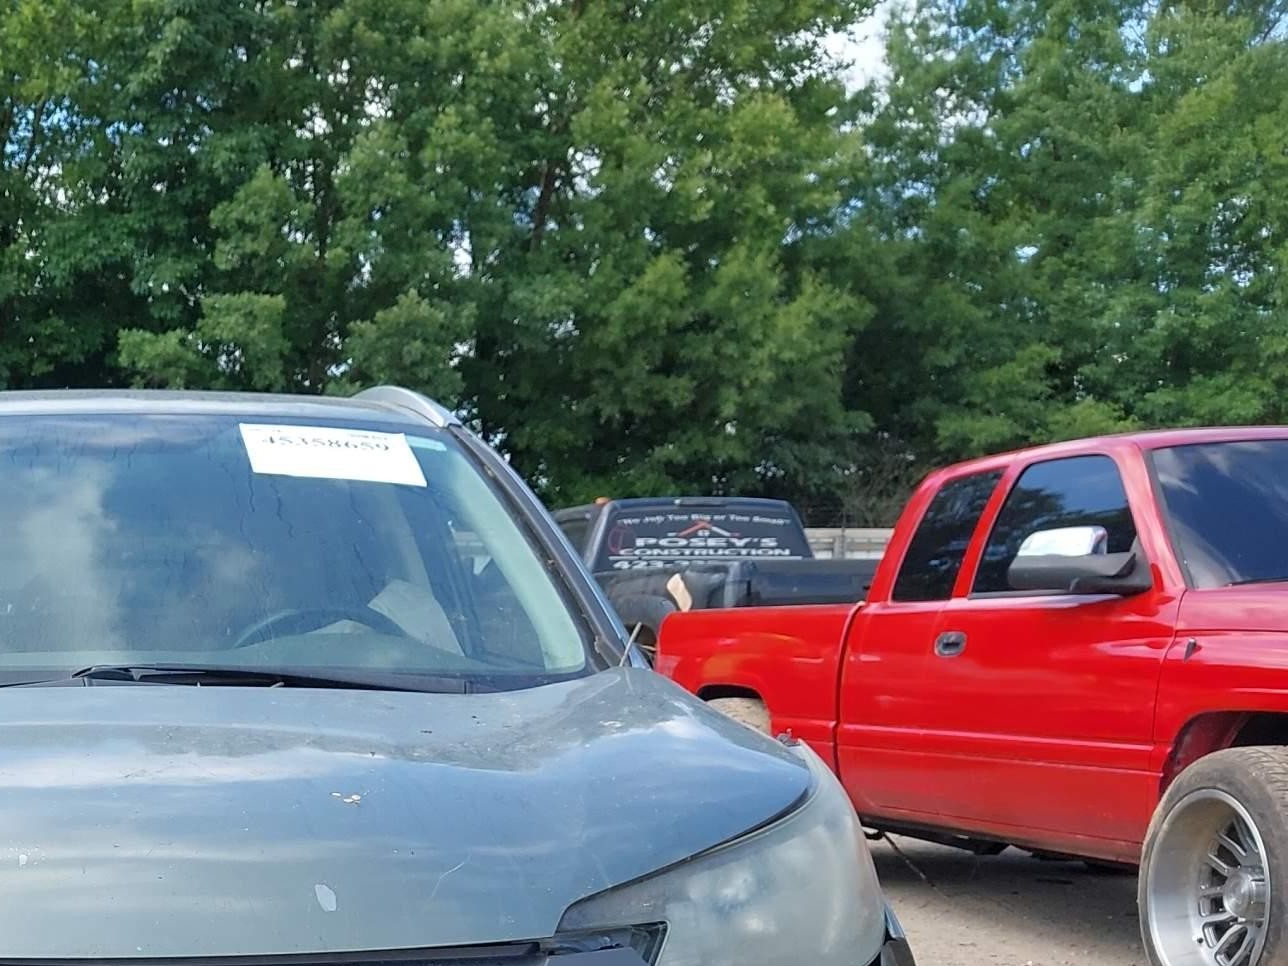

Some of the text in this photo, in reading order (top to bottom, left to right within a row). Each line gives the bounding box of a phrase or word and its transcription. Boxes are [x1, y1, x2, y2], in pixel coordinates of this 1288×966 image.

[728, 513, 750, 521] Too
[635, 537, 779, 548] POSEY'S
[619, 548, 792, 556] CONSTRUCTION
